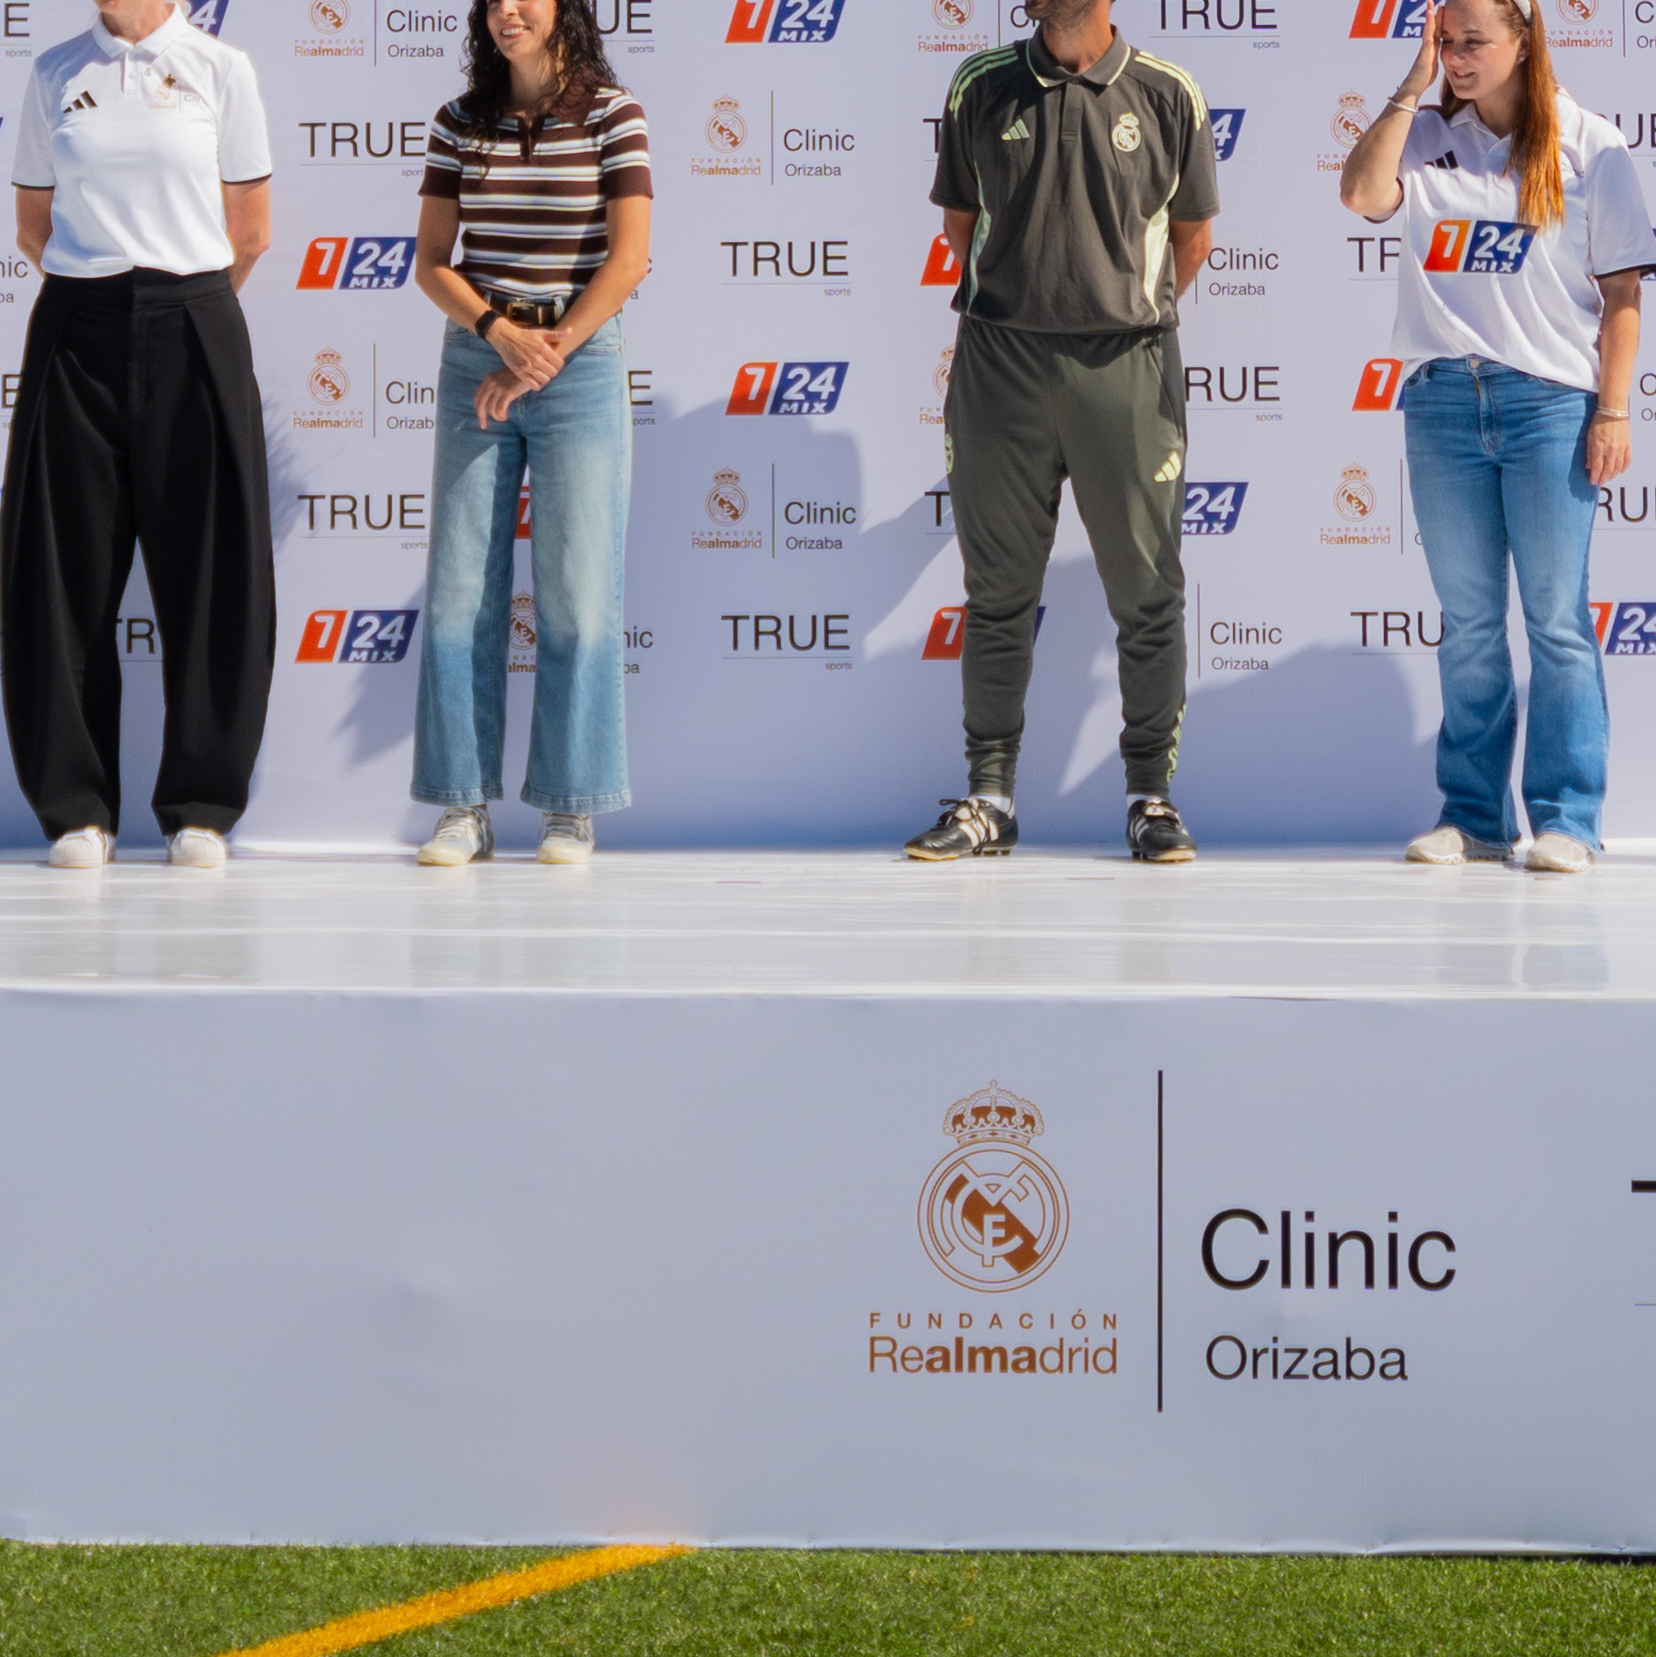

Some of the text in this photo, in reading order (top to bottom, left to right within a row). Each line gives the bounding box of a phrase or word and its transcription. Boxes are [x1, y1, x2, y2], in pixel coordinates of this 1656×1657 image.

[387, 10, 457, 32] Clinic
[777, 30, 827, 41] MIX
[1253, 41, 1280, 49] sports
[388, 44, 444, 57] Orizaba
[299, 122, 426, 157] TRUE
[784, 129, 854, 151] Clinic
[692, 165, 760, 175] Realmadrid
[785, 163, 841, 176] Orizaba
[721, 241, 848, 276] TRUE
[1205, 245, 1278, 270] Clinic
[1471, 260, 1514, 273] MIX
[824, 288, 851, 296] sports
[295, 491, 425, 530] TRUE
[785, 502, 856, 524] Clinic
[786, 537, 842, 550] Orizaba
[1320, 534, 1390, 544] Realmadrid
[721, 615, 850, 651] TRUE
[1211, 622, 1281, 644] Clinic
[1212, 657, 1270, 673] Orizaba
[1202, 1209, 1455, 1291] Clinic
[870, 1309, 1116, 1330] FUNDACIÓN
[870, 1336, 1117, 1374] Realmadrid
[1206, 1335, 1408, 1381] Orizaba
